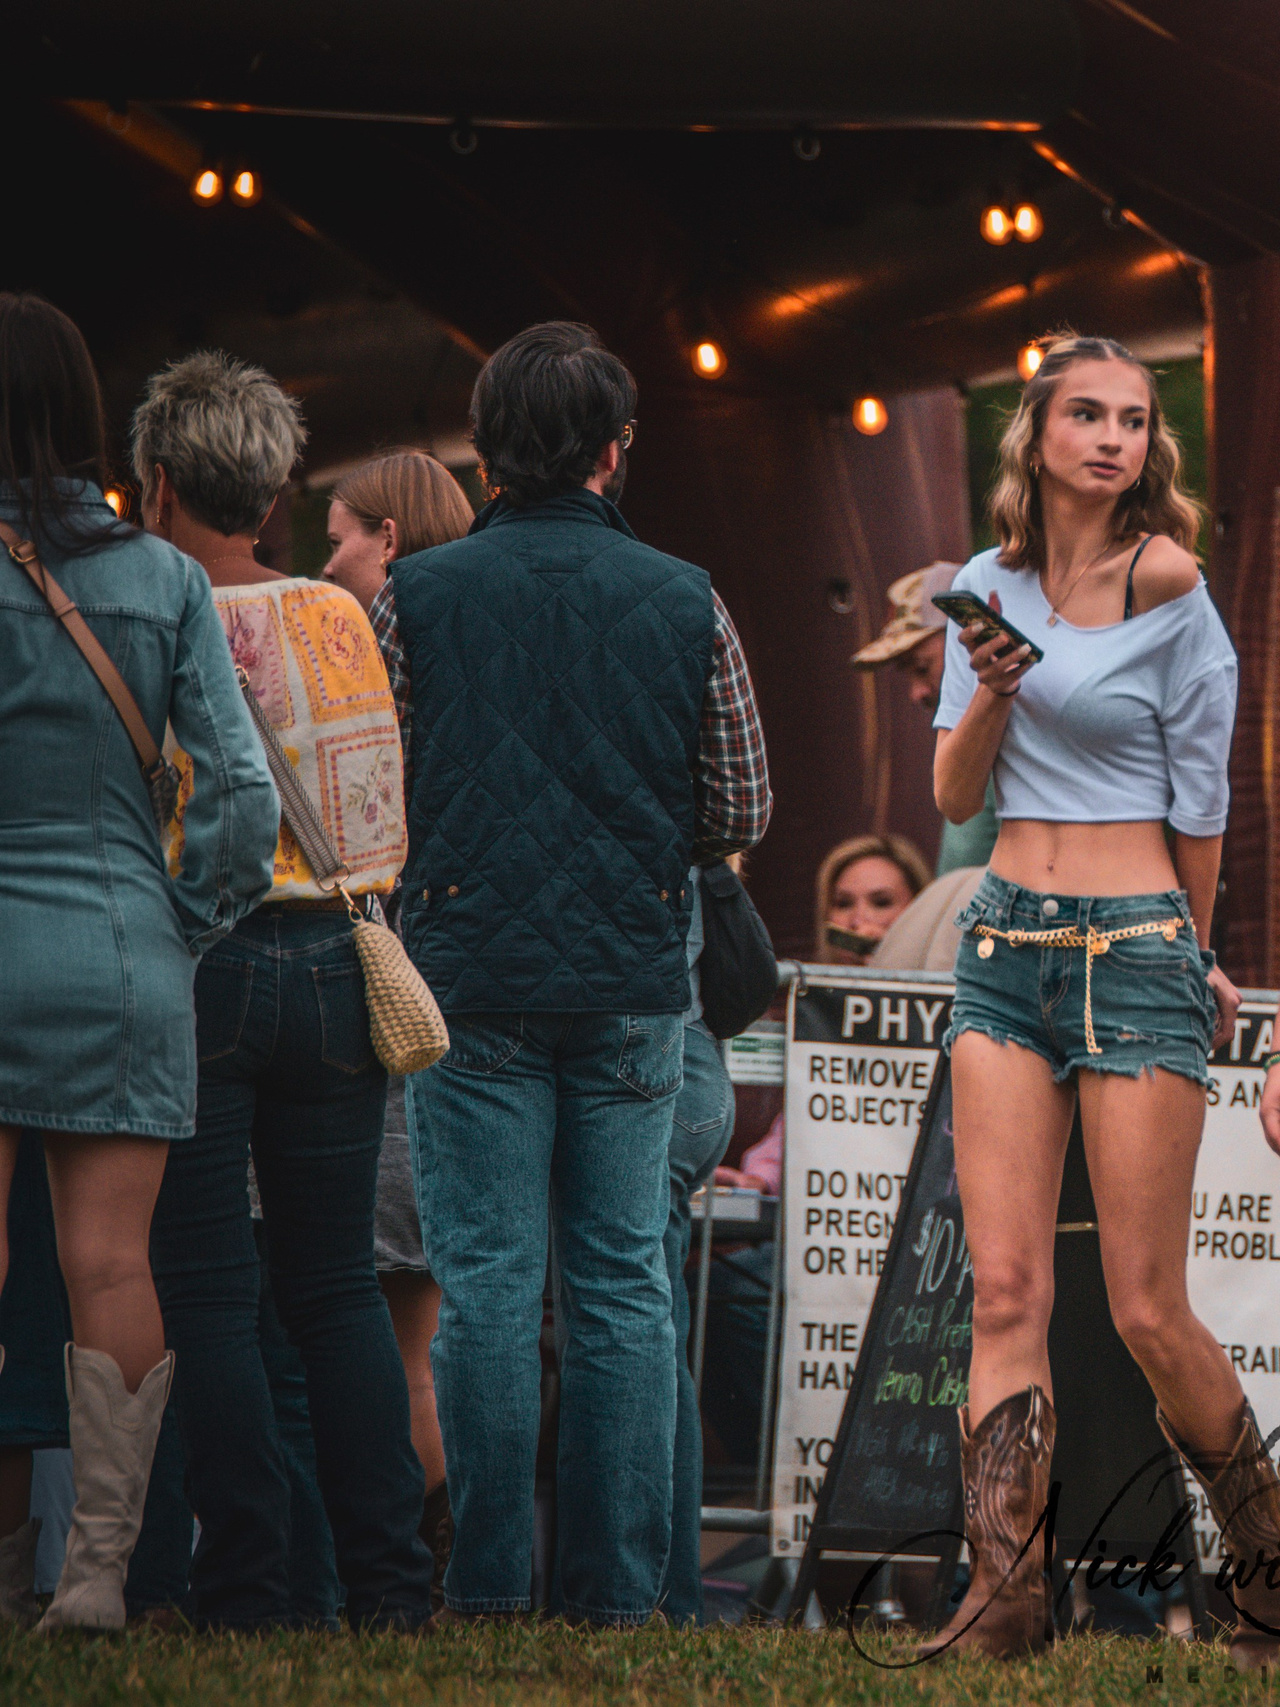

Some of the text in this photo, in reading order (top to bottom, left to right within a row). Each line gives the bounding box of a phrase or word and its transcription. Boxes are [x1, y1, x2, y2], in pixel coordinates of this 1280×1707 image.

[842, 994, 955, 1043] PHY
[809, 1055, 928, 1090] REMOVE
[1230, 1081, 1264, 1109] AN
[806, 1170, 847, 1199] DO
[1216, 1193, 1272, 1223] ARE
[804, 1246, 847, 1276] OR
[801, 1322, 858, 1352] THE
